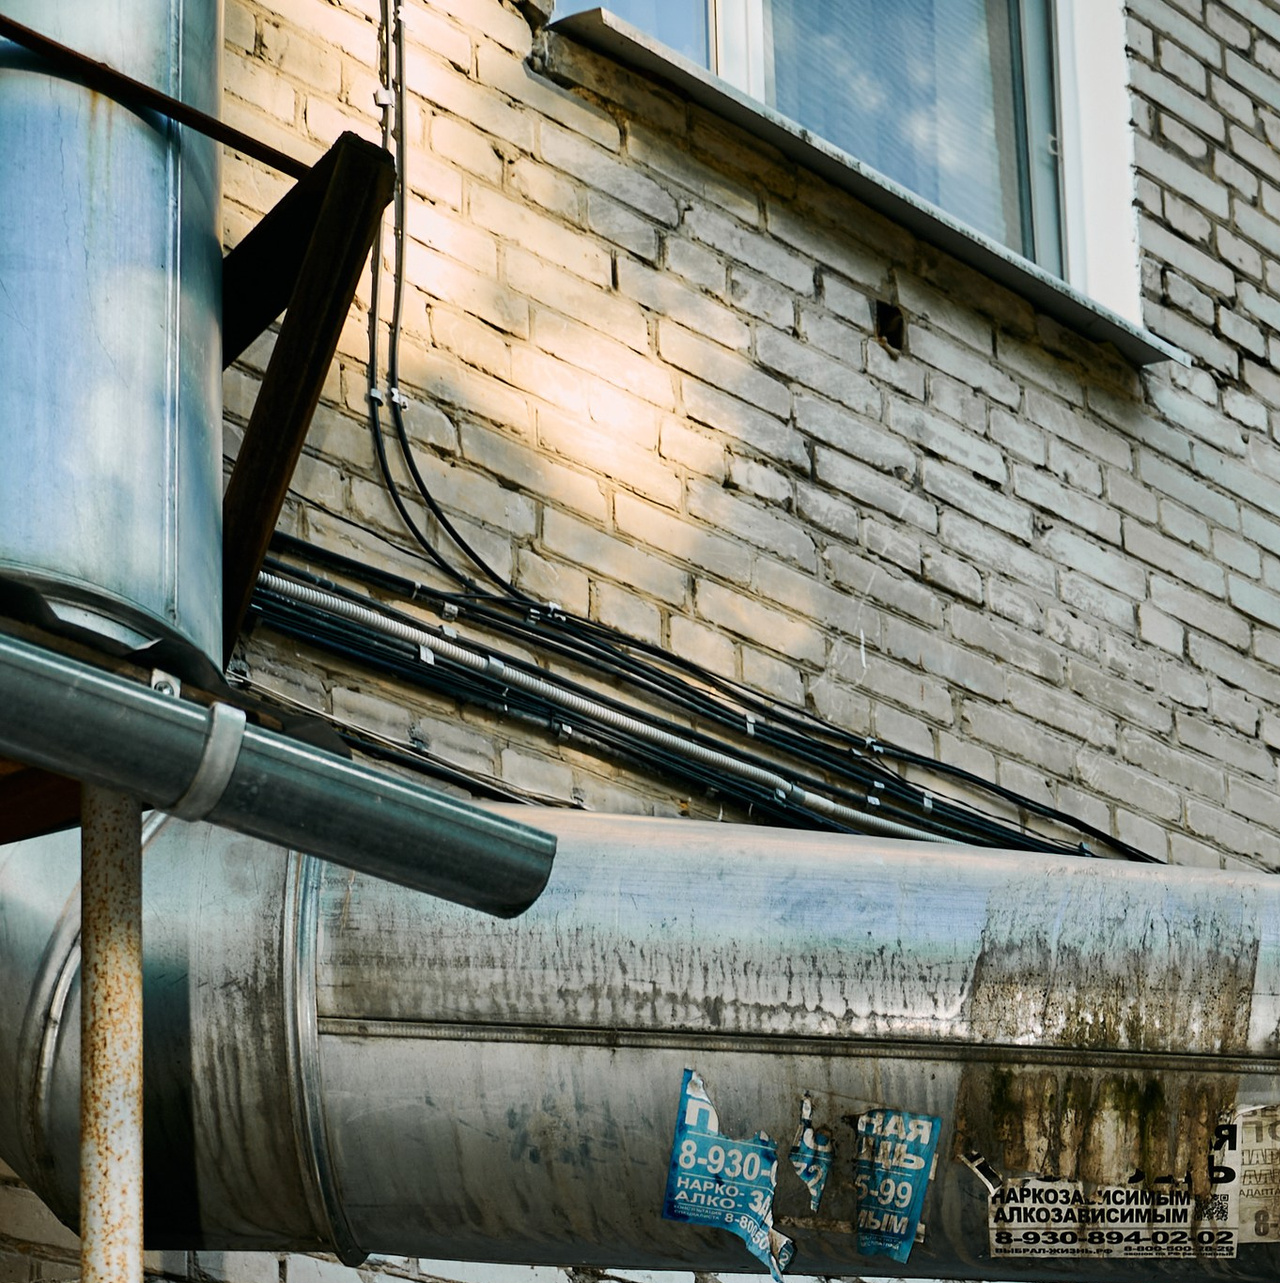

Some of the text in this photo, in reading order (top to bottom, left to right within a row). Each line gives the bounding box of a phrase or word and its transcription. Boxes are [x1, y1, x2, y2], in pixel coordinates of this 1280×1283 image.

[992, 1188, 1191, 1206] НАРКОЗАИСИМЫМ
[993, 1207, 1188, 1224] АЛКОЗАВИСИМЫМ
[995, 1231, 1234, 1245] 8-930-894-02-02
